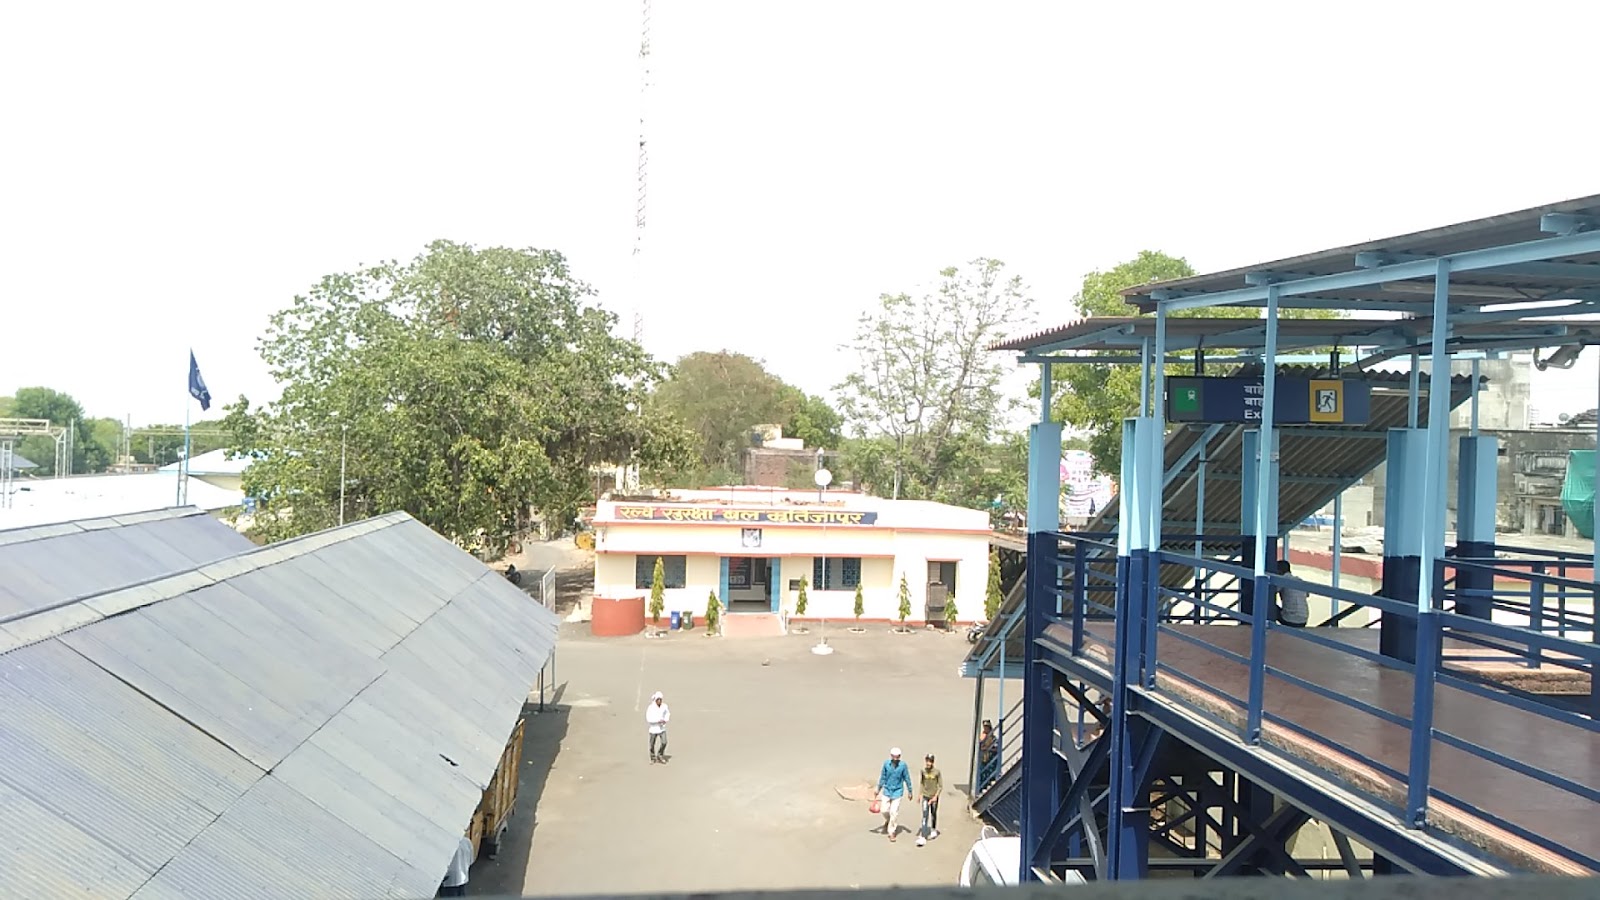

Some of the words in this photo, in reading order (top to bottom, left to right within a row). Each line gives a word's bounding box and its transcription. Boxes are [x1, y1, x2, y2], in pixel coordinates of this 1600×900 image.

[1243, 382, 1264, 396] बाहे
[1243, 397, 1264, 407] बाह
[1244, 409, 1261, 419] Ex
[722, 509, 760, 521] बल
